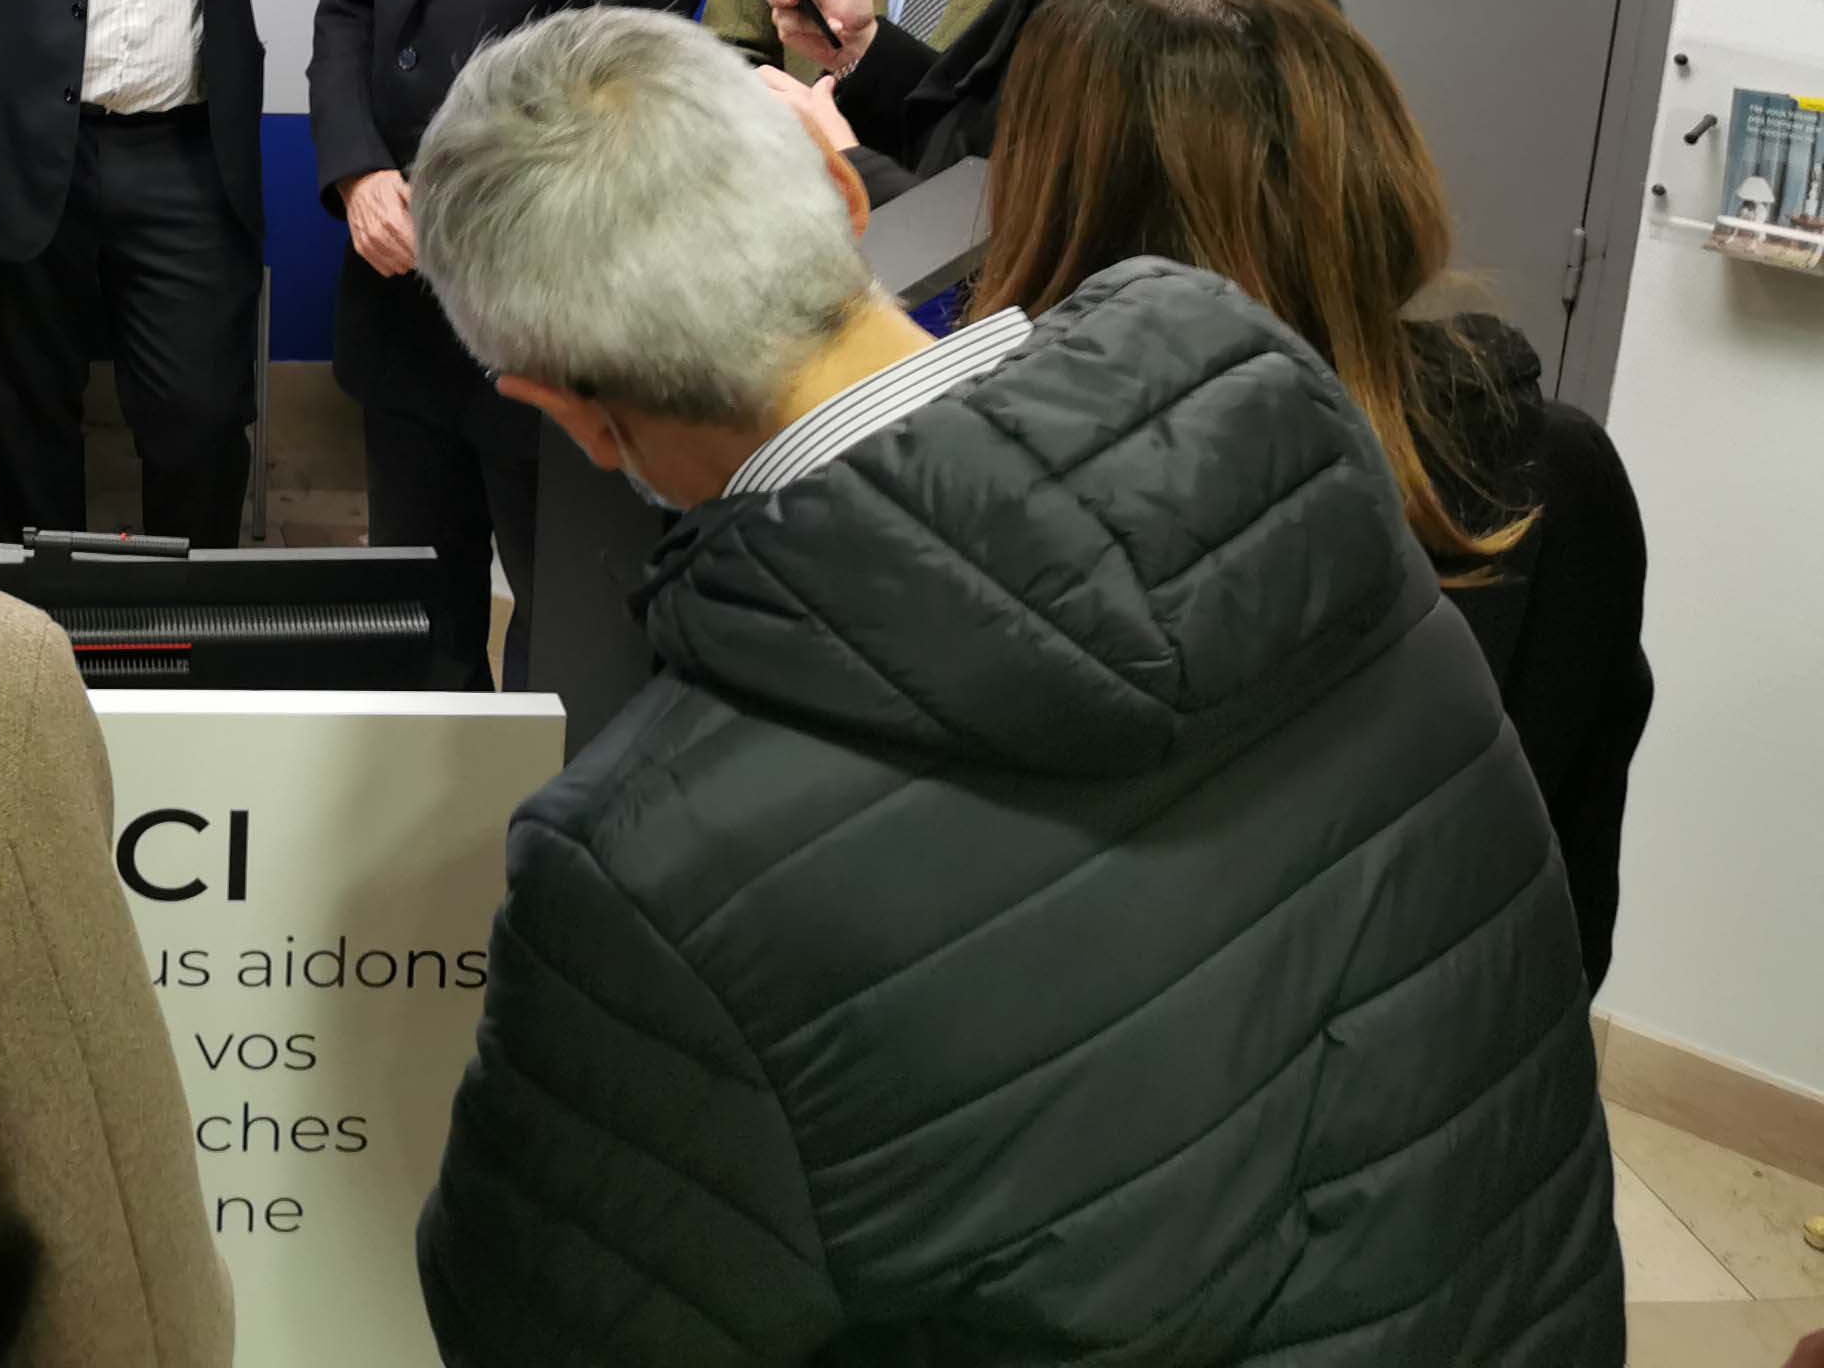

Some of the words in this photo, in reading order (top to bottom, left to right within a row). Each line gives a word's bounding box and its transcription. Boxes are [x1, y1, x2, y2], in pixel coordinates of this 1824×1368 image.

[116, 808, 249, 902] CI
[237, 936, 487, 989] aidons
[194, 1033, 317, 1071] vos
[196, 1102, 368, 1153] ches
